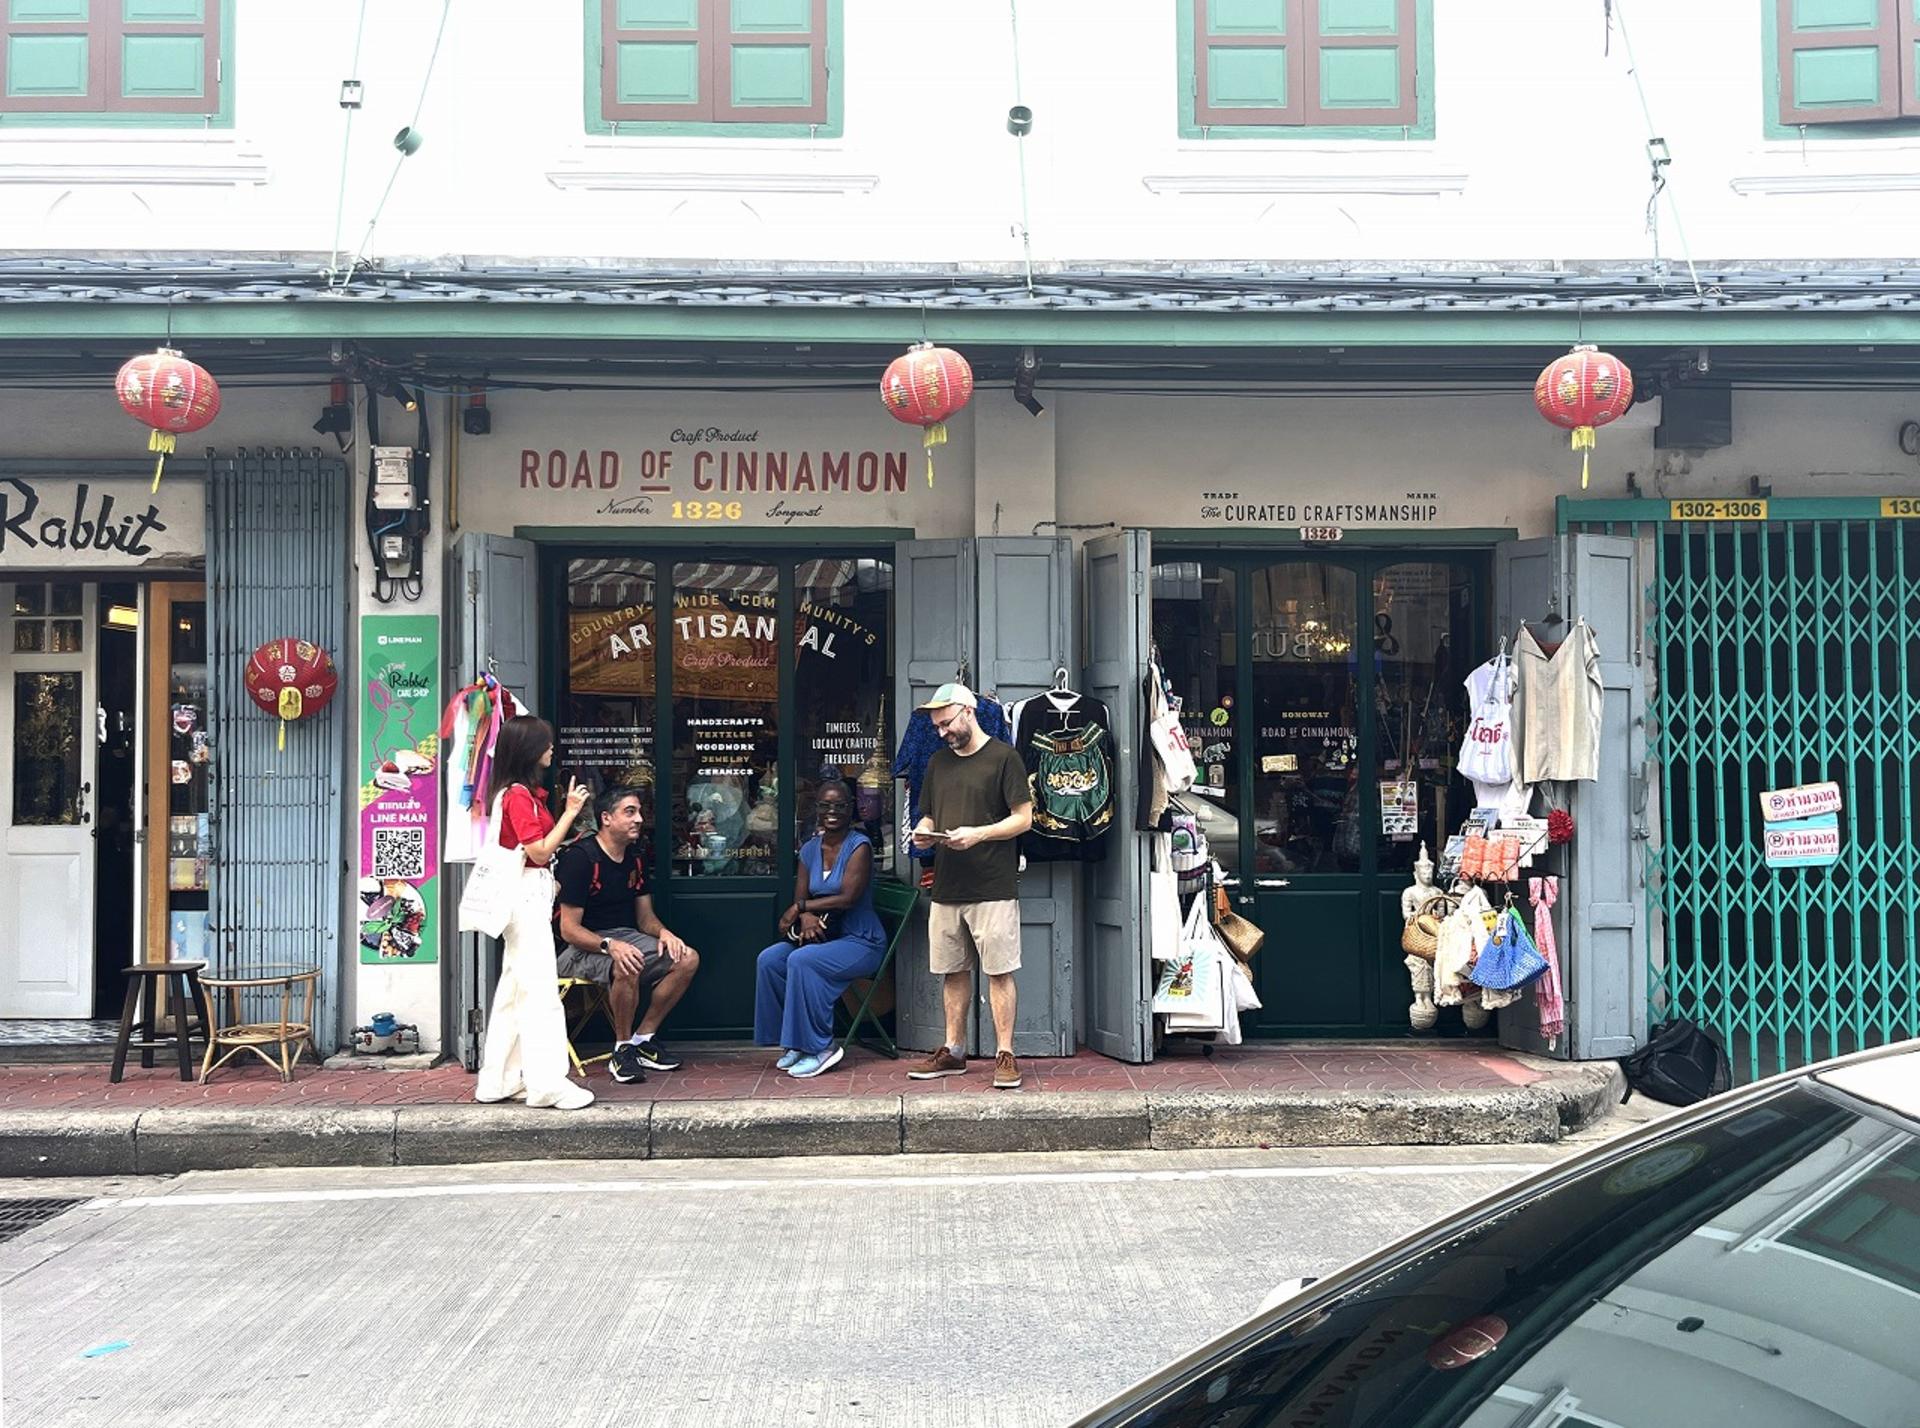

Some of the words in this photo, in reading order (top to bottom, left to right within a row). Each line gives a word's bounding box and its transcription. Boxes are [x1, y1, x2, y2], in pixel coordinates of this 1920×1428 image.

[670, 428, 704, 445] Craft
[705, 427, 759, 442] Product
[520, 449, 620, 492] ROAD
[640, 450, 674, 483] OF
[693, 450, 909, 493] CINNAMON
[597, 496, 653, 516] Number
[672, 501, 742, 519] 1326
[766, 500, 824, 525] Songwat
[1201, 506, 1222, 519] The
[1225, 505, 1296, 521] CURATED
[1304, 505, 1438, 522] CRAFTSMANSHIP
[1676, 502, 1761, 517] 1302-1306
[0, 479, 167, 555] Rabbit
[1304, 526, 1338, 540] 1326
[676, 594, 720, 609] WIDE
[682, 652, 716, 671] Craft
[716, 652, 769, 668] Product
[389, 671, 429, 688] Rabbit
[687, 718, 764, 726] HANDICRAFTS
[1185, 727, 1233, 737] CINNAMON
[1261, 727, 1286, 737] ROAD
[1301, 727, 1350, 737] CINNAMON
[696, 743, 755, 751] WOODWORK
[812, 738, 844, 750] LOCALLY
[845, 737, 879, 749] CRAFTED
[824, 754, 865, 764] TREASURES
[697, 768, 755, 776] CERAMICS
[370, 813, 397, 823] LINE
[399, 813, 427, 823] MAN
[1786, 832, 1836, 846] ห้ามจอด
